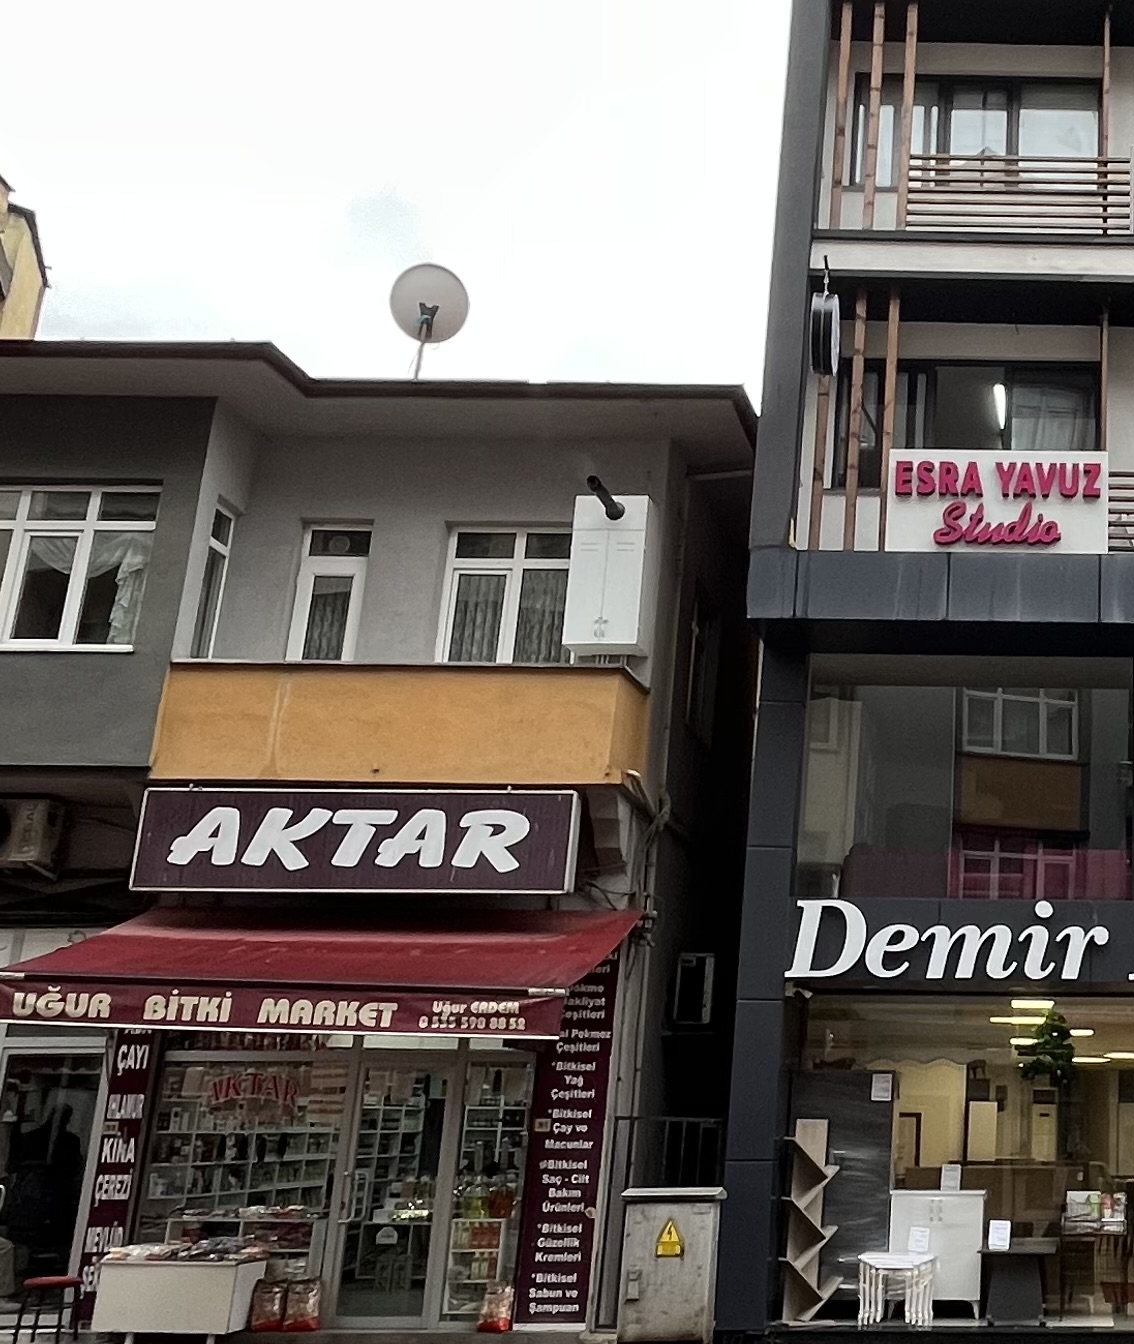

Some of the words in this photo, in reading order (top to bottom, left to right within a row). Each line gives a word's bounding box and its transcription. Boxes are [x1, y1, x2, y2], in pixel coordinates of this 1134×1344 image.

[895, 461, 983, 498] ESRA
[995, 462, 1102, 499] YAVUZ
[933, 502, 1062, 546] Studio
[167, 807, 531, 873] AKTAR
[784, 899, 1110, 980] Demir
[12, 985, 113, 1019] UĞUR
[143, 988, 233, 1023] BİTKİ
[256, 998, 399, 1028] MARKET
[432, 1001, 467, 1017] Uğur
[419, 1016, 429, 1029] 0
[117, 1044, 149, 1076] ÇAYI
[564, 1075, 584, 1087] Yağ
[553, 1122, 573, 1135] Çay
[575, 1124, 588, 1132] ve
[544, 1139, 594, 1149] Macunlar
[541, 1173, 562, 1186] Saç
[571, 1173, 590, 1184] Cilt
[541, 1200, 585, 1213] Ürünleri
[534, 1251, 582, 1263] Kremleri
[528, 1287, 563, 1299] Sabun
[565, 1289, 578, 1298] ve
[528, 1302, 580, 1315] Şampuan
